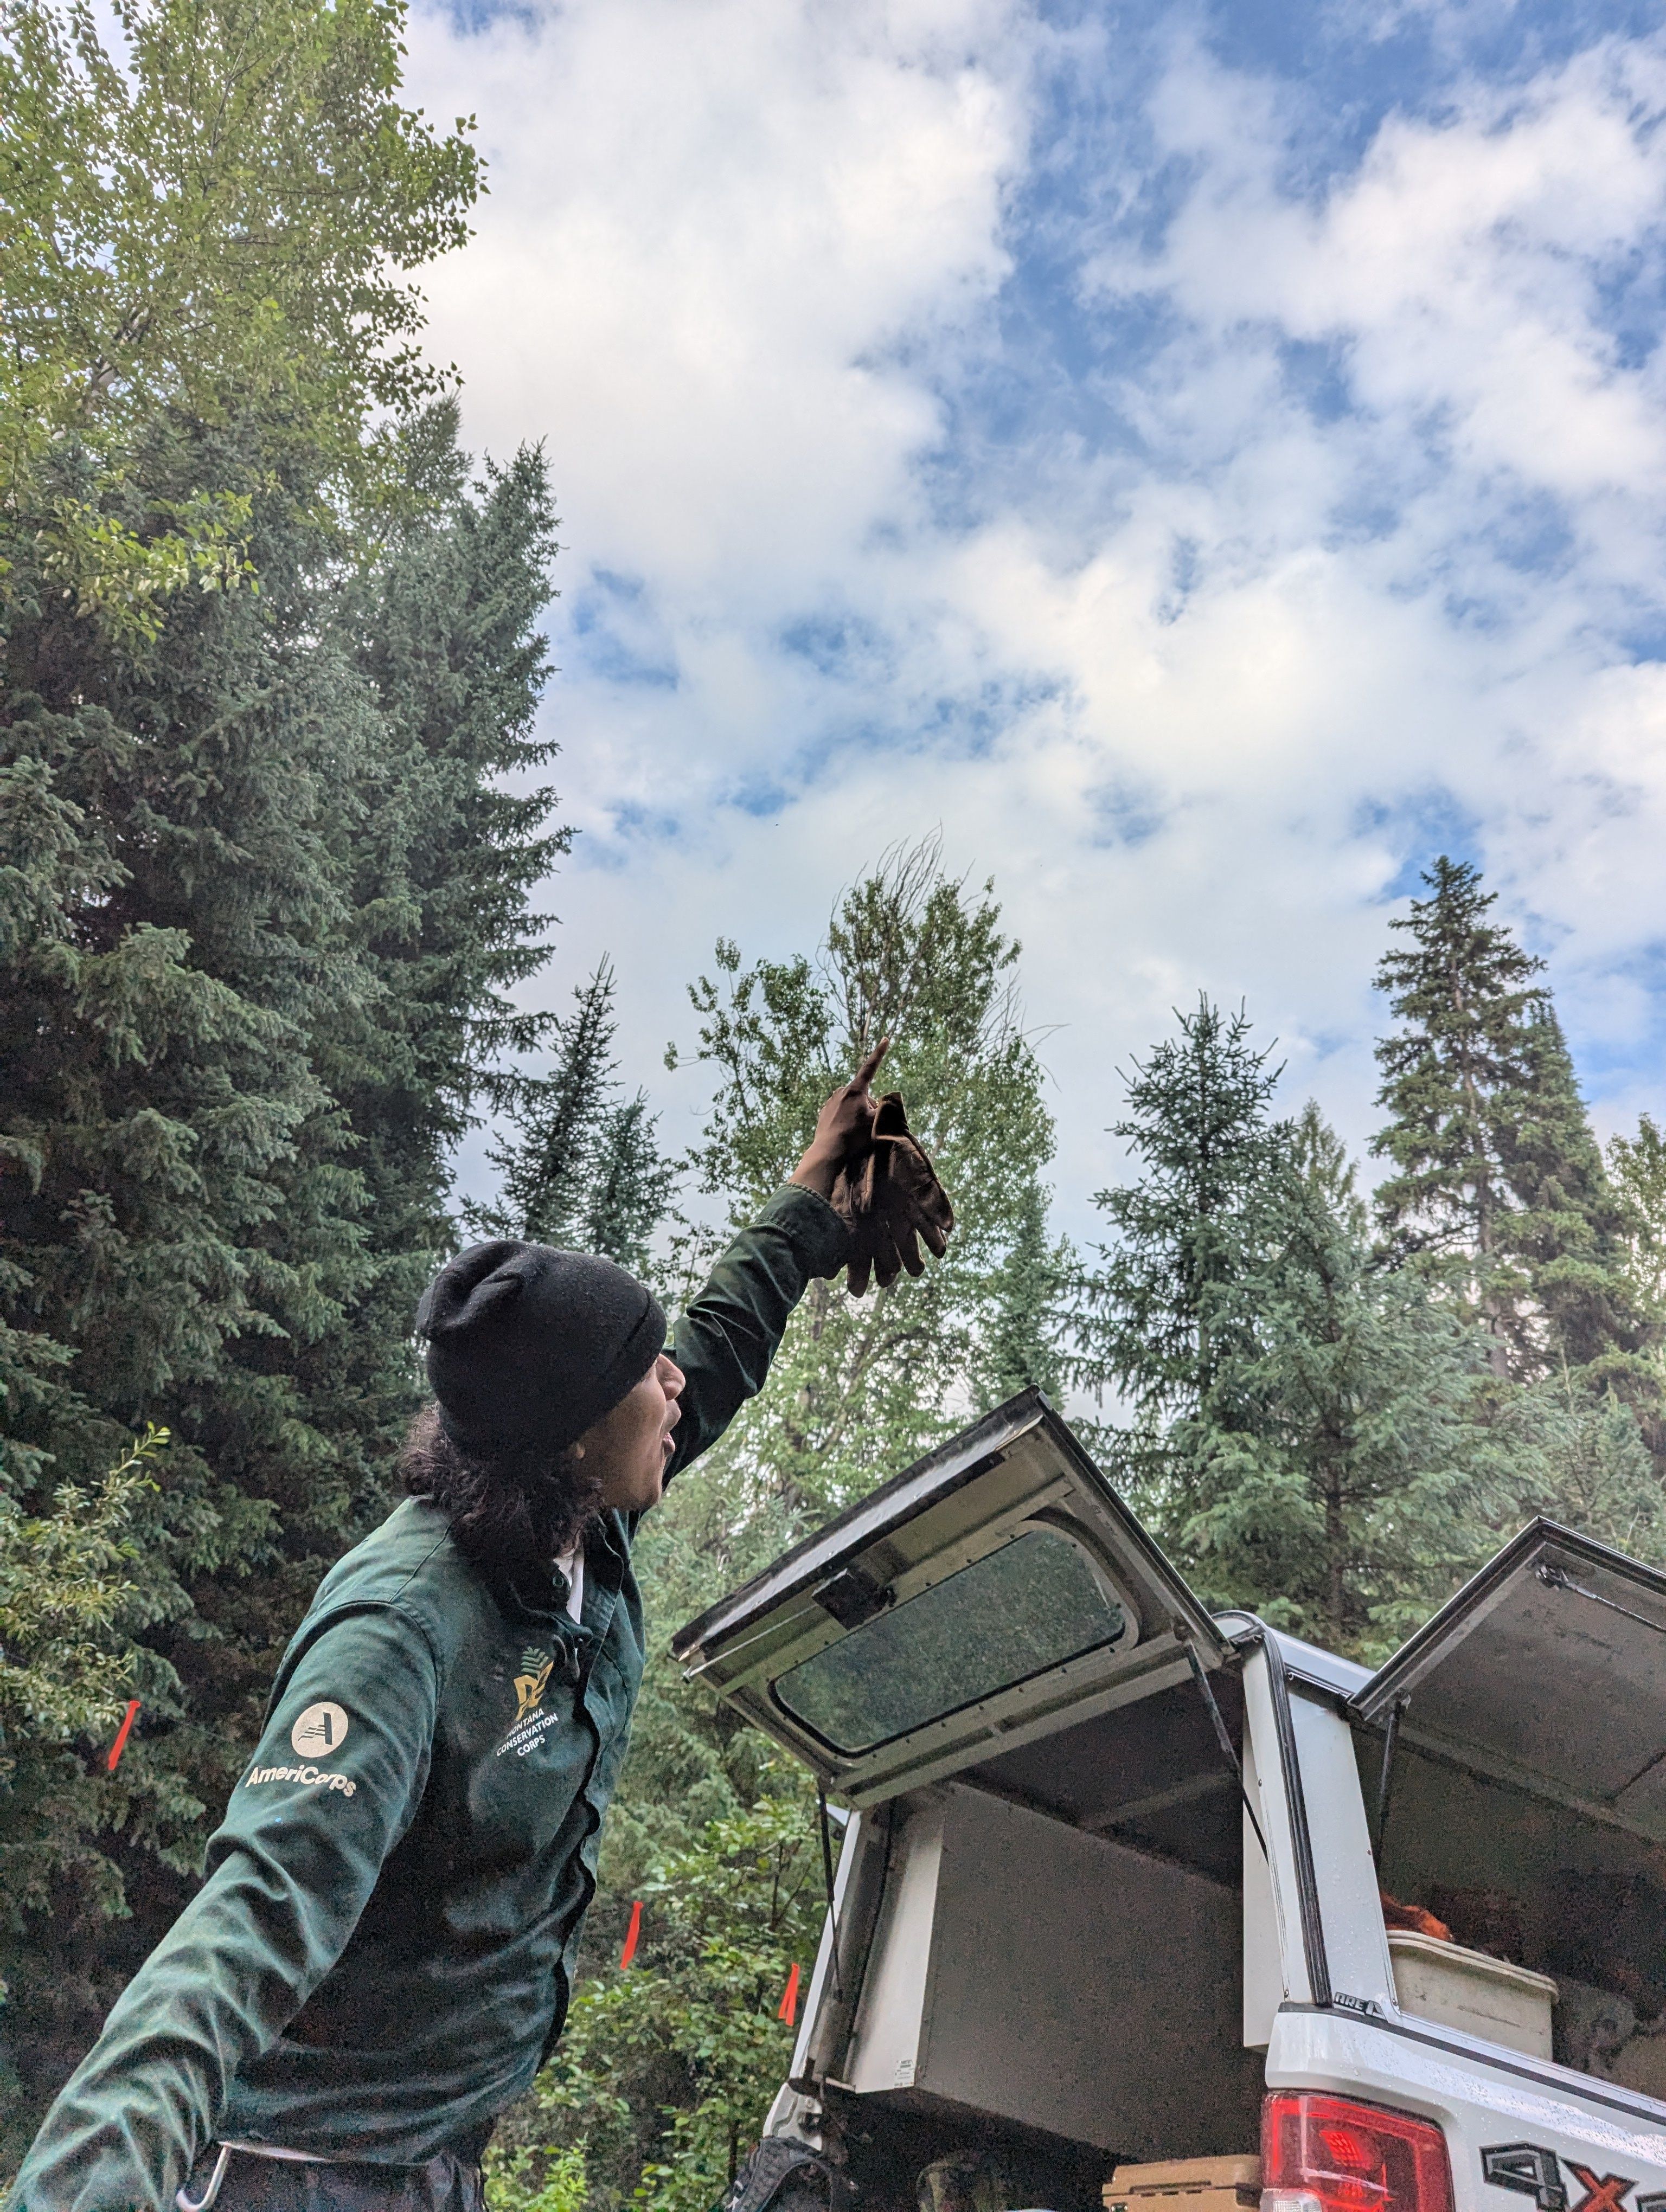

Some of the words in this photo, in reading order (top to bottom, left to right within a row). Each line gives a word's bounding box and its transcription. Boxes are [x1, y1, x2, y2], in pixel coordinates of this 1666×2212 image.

[497, 1713, 558, 1756] CONSERVATION
[517, 1735, 545, 1756] CORPS
[245, 1765, 356, 1797] AmeriCorps
[1479, 2140, 1666, 2212] 4X
